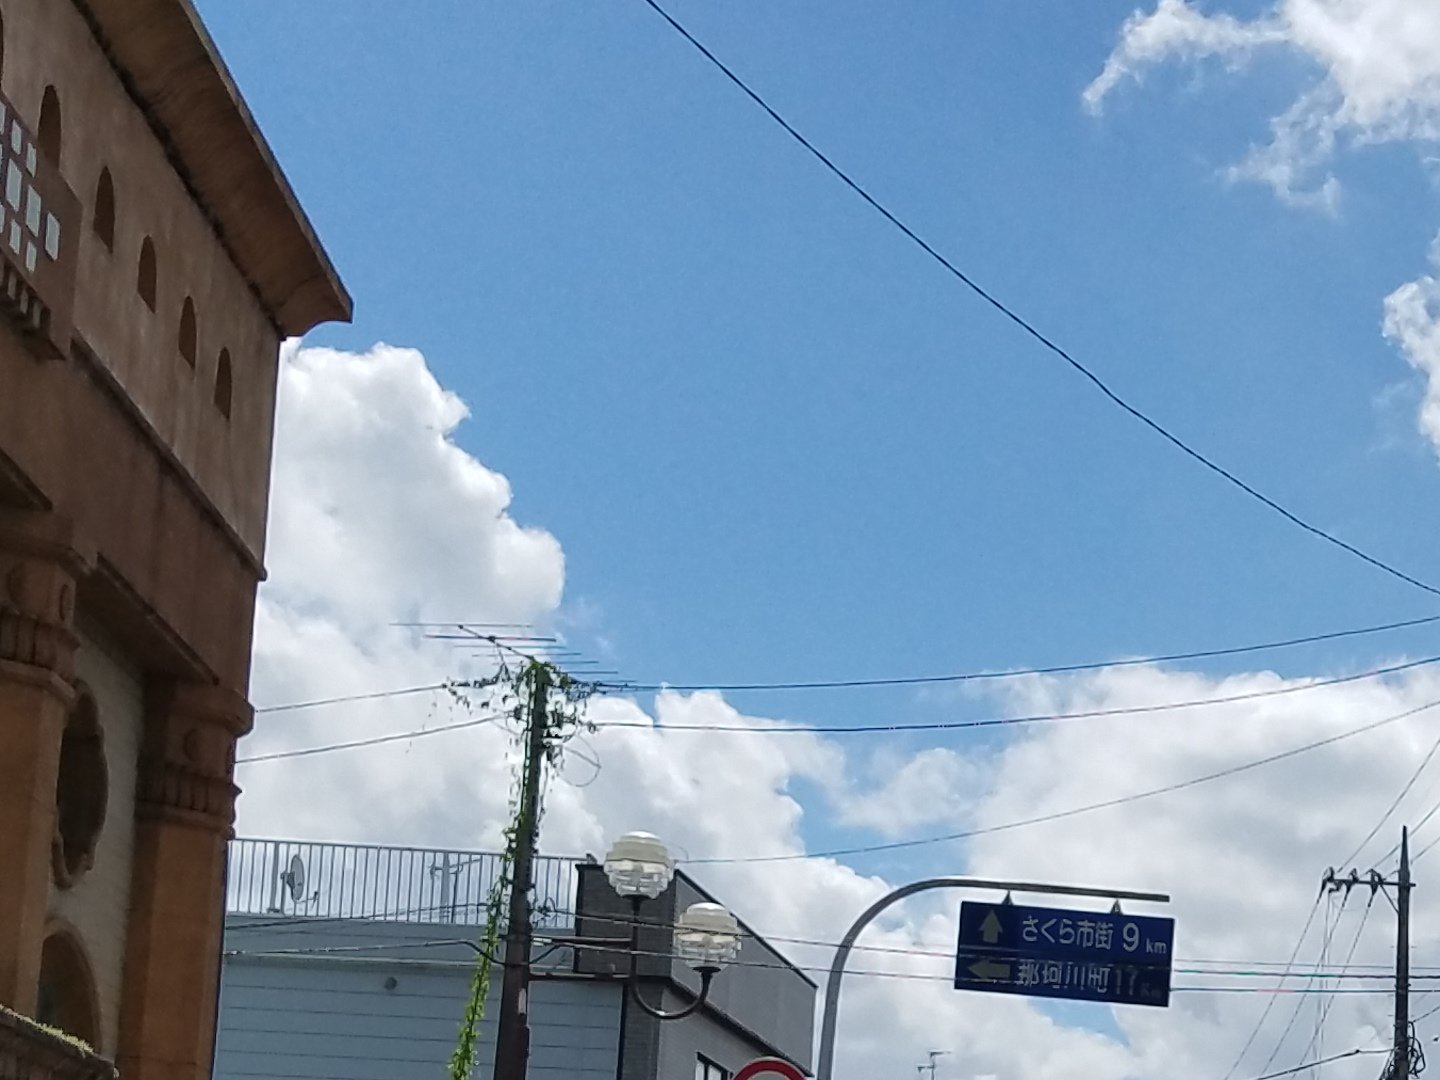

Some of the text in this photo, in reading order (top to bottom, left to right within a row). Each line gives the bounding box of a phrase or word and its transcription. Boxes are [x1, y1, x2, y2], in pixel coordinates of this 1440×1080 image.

[1022, 915, 1113, 950] さくら市街
[1122, 922, 1140, 951] 9
